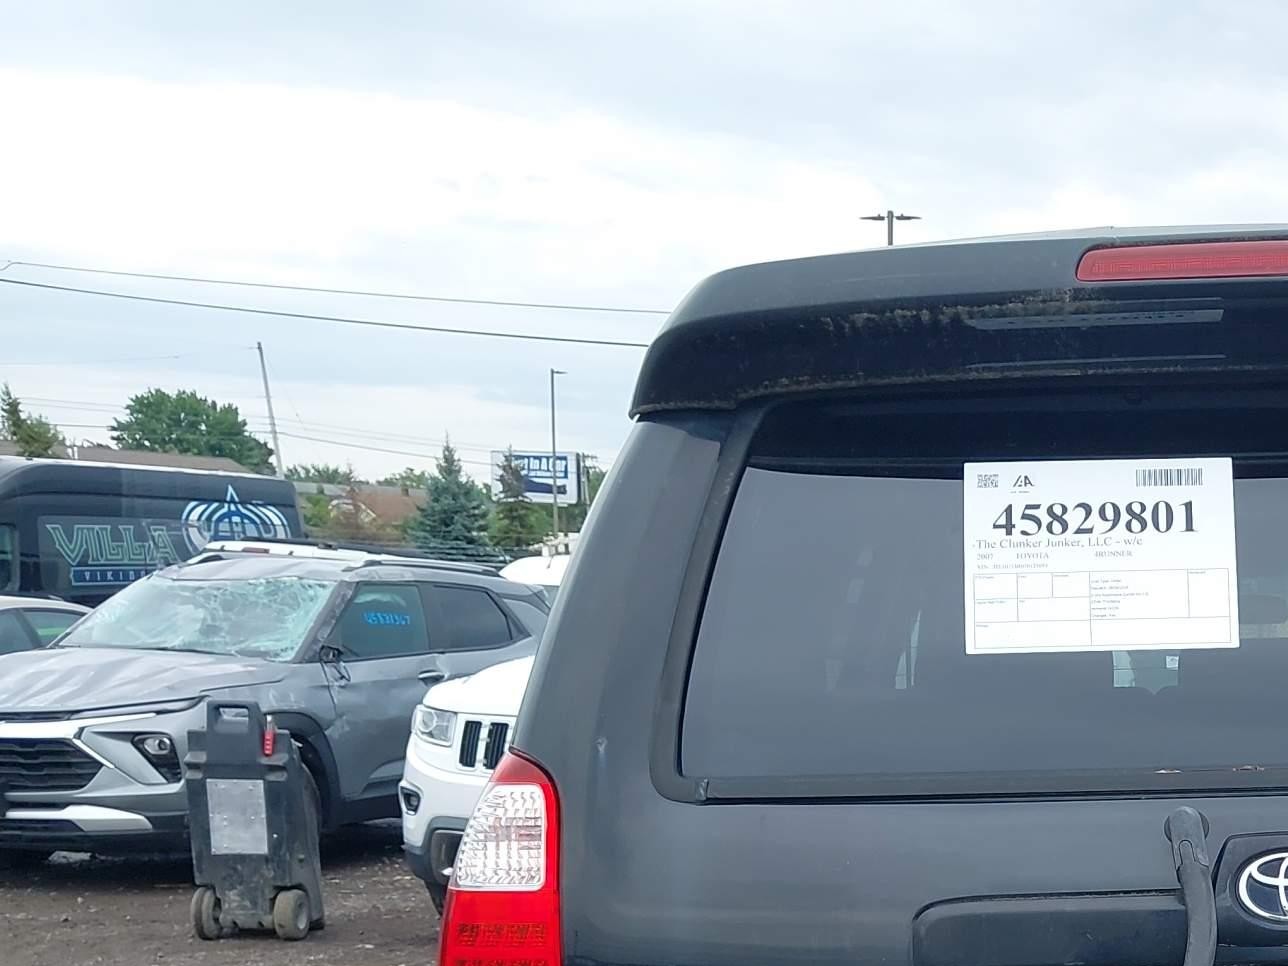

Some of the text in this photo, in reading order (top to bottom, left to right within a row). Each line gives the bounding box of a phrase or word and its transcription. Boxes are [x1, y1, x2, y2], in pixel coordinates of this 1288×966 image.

[992, 500, 1198, 536] 45829801
[46, 524, 181, 566] VILLA
[999, 538, 1042, 549] Clunker
[1045, 537, 1085, 548] Junker,
[1088, 536, 1112, 547] LLC
[1016, 552, 1050, 560] TOYOTA
